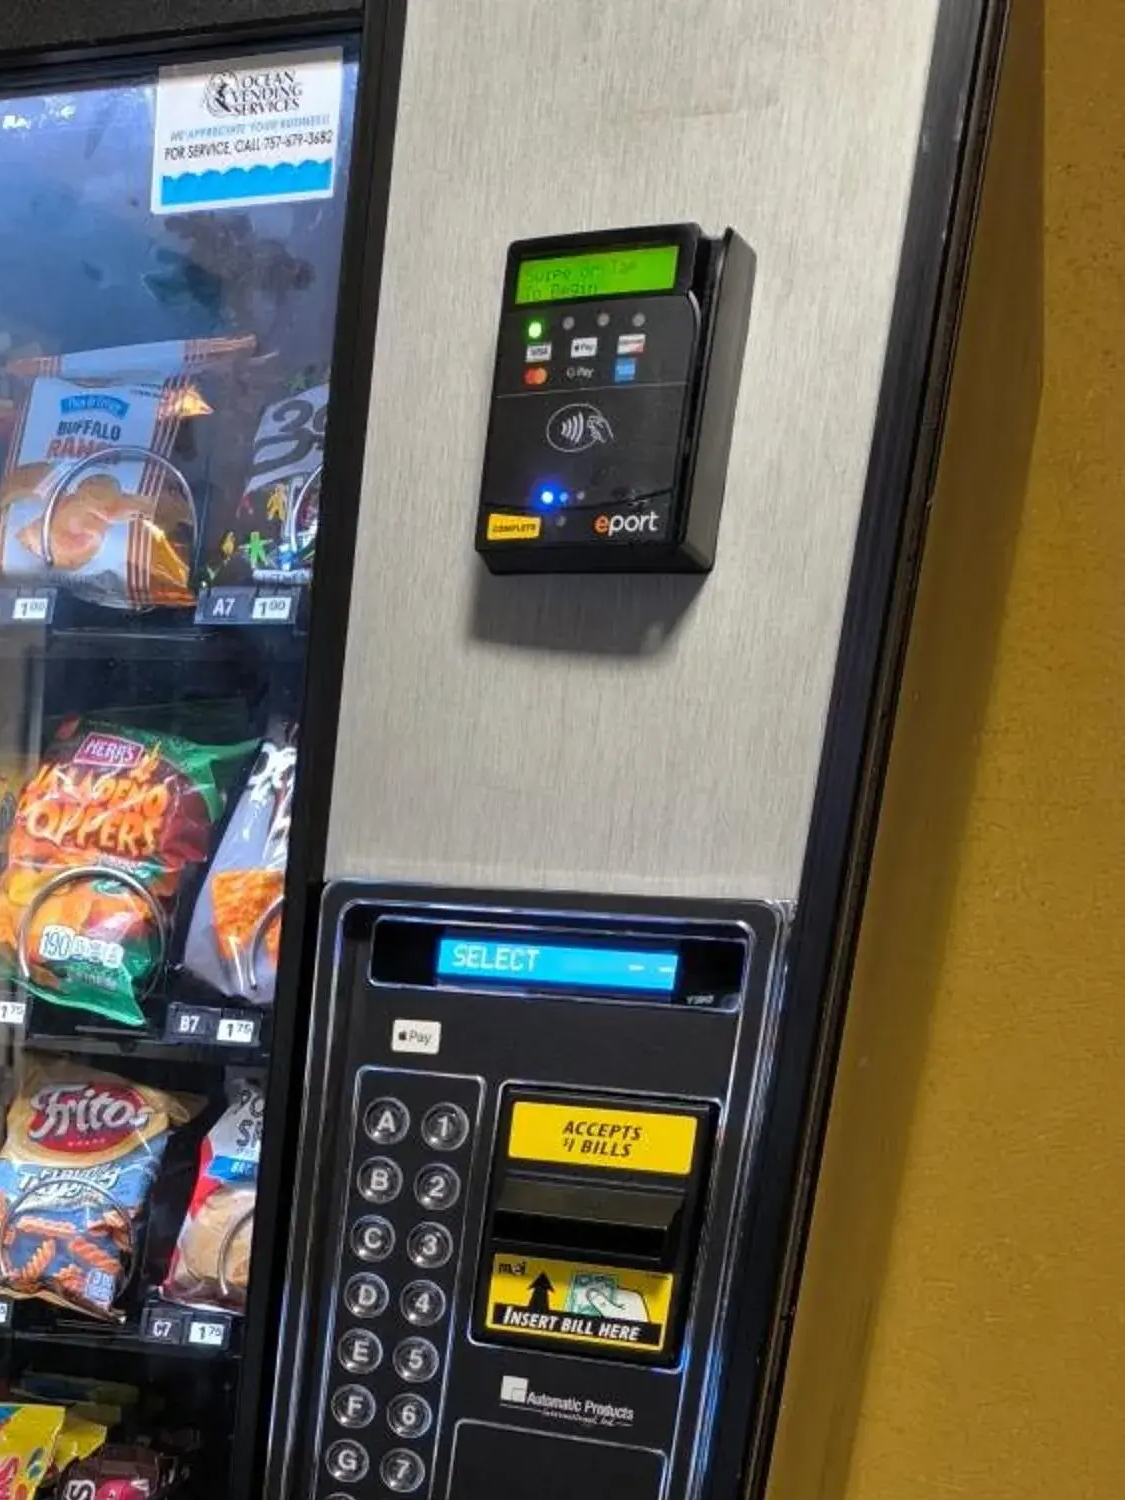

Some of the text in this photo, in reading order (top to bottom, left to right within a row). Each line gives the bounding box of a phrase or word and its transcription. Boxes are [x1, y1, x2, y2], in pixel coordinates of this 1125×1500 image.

[241, 70, 295, 90] OCEAN
[230, 83, 303, 103] VENDING
[233, 98, 300, 116] SERVICES
[163, 146, 185, 161] FOR
[233, 138, 261, 154] CALL
[56, 419, 122, 442] BUFFALO
[594, 510, 660, 537] eport
[212, 599, 236, 617] A7
[452, 943, 541, 972] SELECT
[178, 1016, 201, 1034] B7
[408, 1029, 433, 1046] Pay
[29, 1083, 153, 1141] Fritos
[376, 1111, 396, 1132] A
[437, 1114, 450, 1136] 1
[562, 1120, 644, 1142] ACCEPTS
[580, 1139, 633, 1159] BILLS
[370, 1170, 389, 1190] B
[428, 1176, 445, 1198] 2
[364, 1227, 383, 1249] C
[422, 1234, 437, 1255] 3
[358, 1285, 377, 1305] D
[414, 1292, 429, 1313] 4
[152, 1321, 172, 1338] C7
[502, 1305, 642, 1341] INSERT BILL HERE
[352, 1342, 369, 1362] E
[408, 1349, 423, 1369] 5
[347, 1396, 362, 1416] F
[402, 1406, 416, 1426] 6
[527, 1391, 582, 1413] Automatic
[583, 1399, 635, 1421] Products
[338, 1450, 356, 1471] G
[395, 1460, 411, 1480] 7
